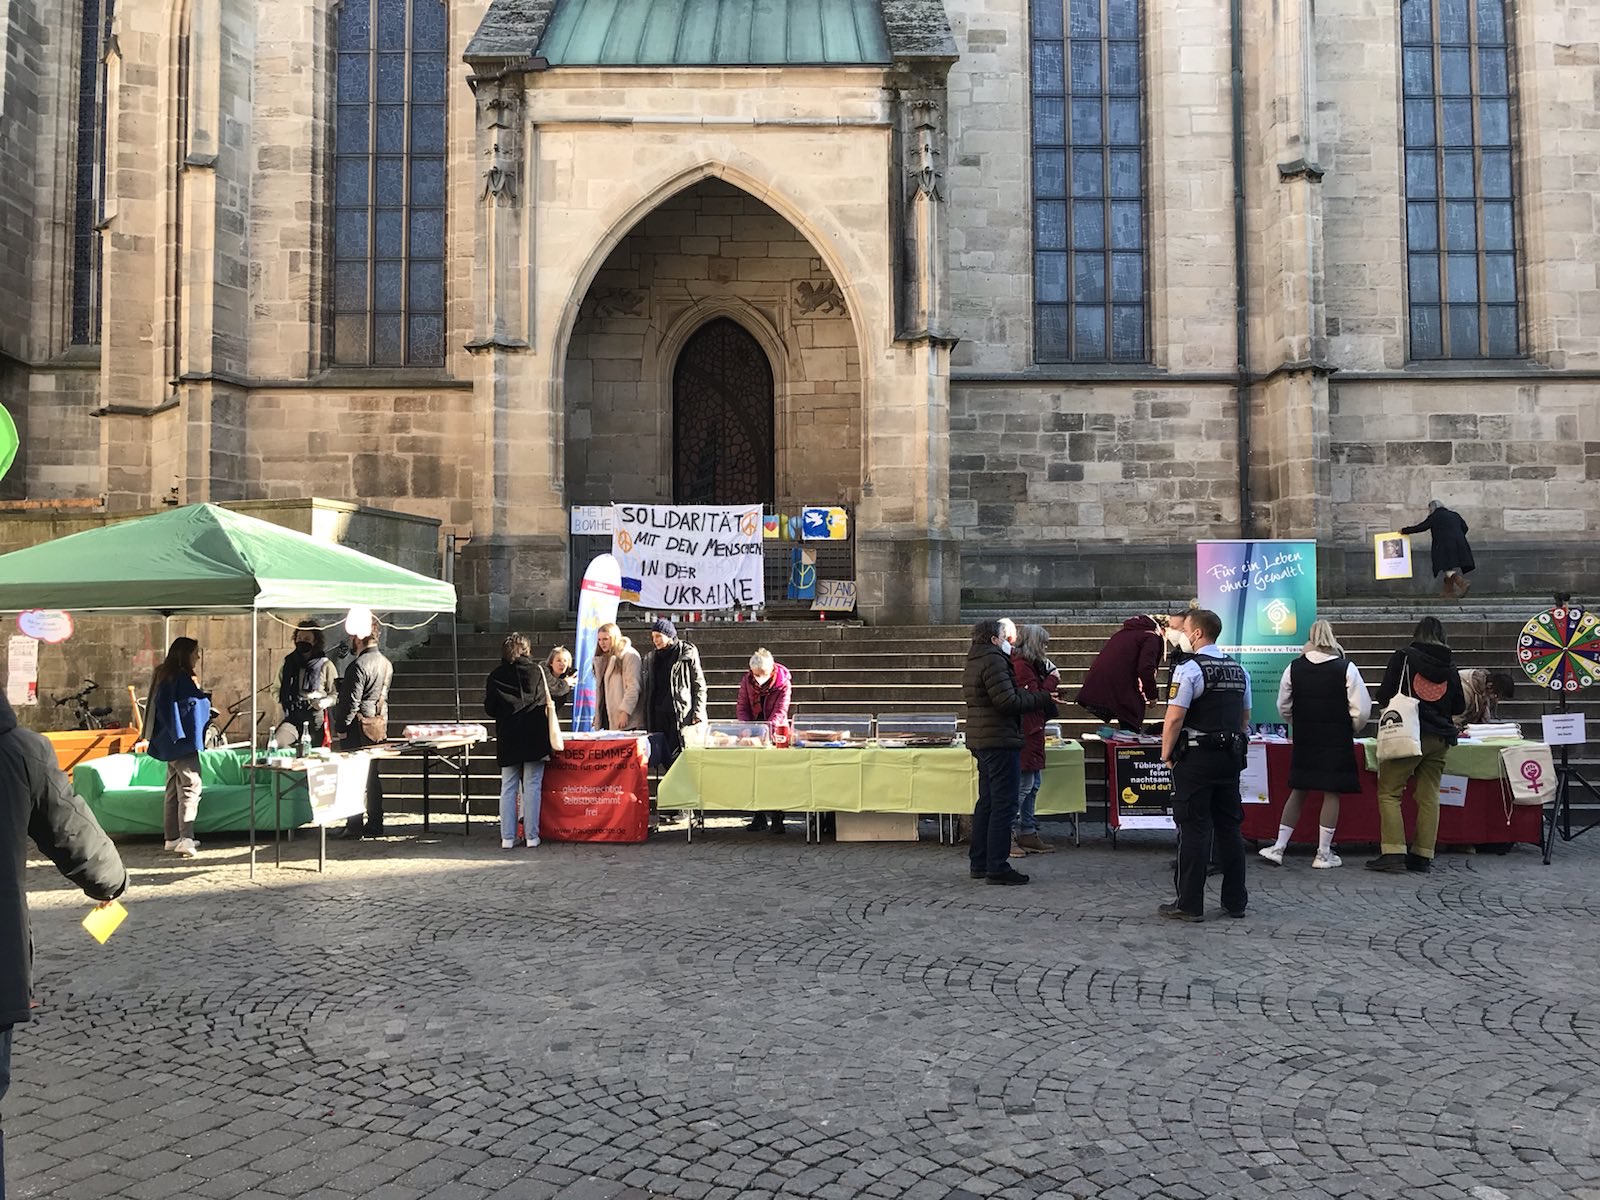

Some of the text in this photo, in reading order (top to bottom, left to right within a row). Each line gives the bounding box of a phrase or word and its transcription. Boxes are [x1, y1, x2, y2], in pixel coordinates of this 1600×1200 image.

[582, 508, 604, 517] НЕТ
[622, 507, 744, 533] SOLIDARITÄT
[634, 531, 763, 557] MIT DEN MENSCHEN
[641, 560, 696, 579] IN DER
[1206, 551, 1303, 580] Für ein Leben
[1219, 563, 1305, 593] ohne Gewalt!
[663, 578, 753, 606] UKRAINE
[818, 581, 857, 596] STAND
[815, 596, 855, 607] WITH
[1205, 666, 1243, 681] POLIZE
[564, 749, 585, 760] DES
[588, 747, 633, 760] FEMMES
[1133, 762, 1167, 771] Tübinge
[585, 807, 598, 817] frei
